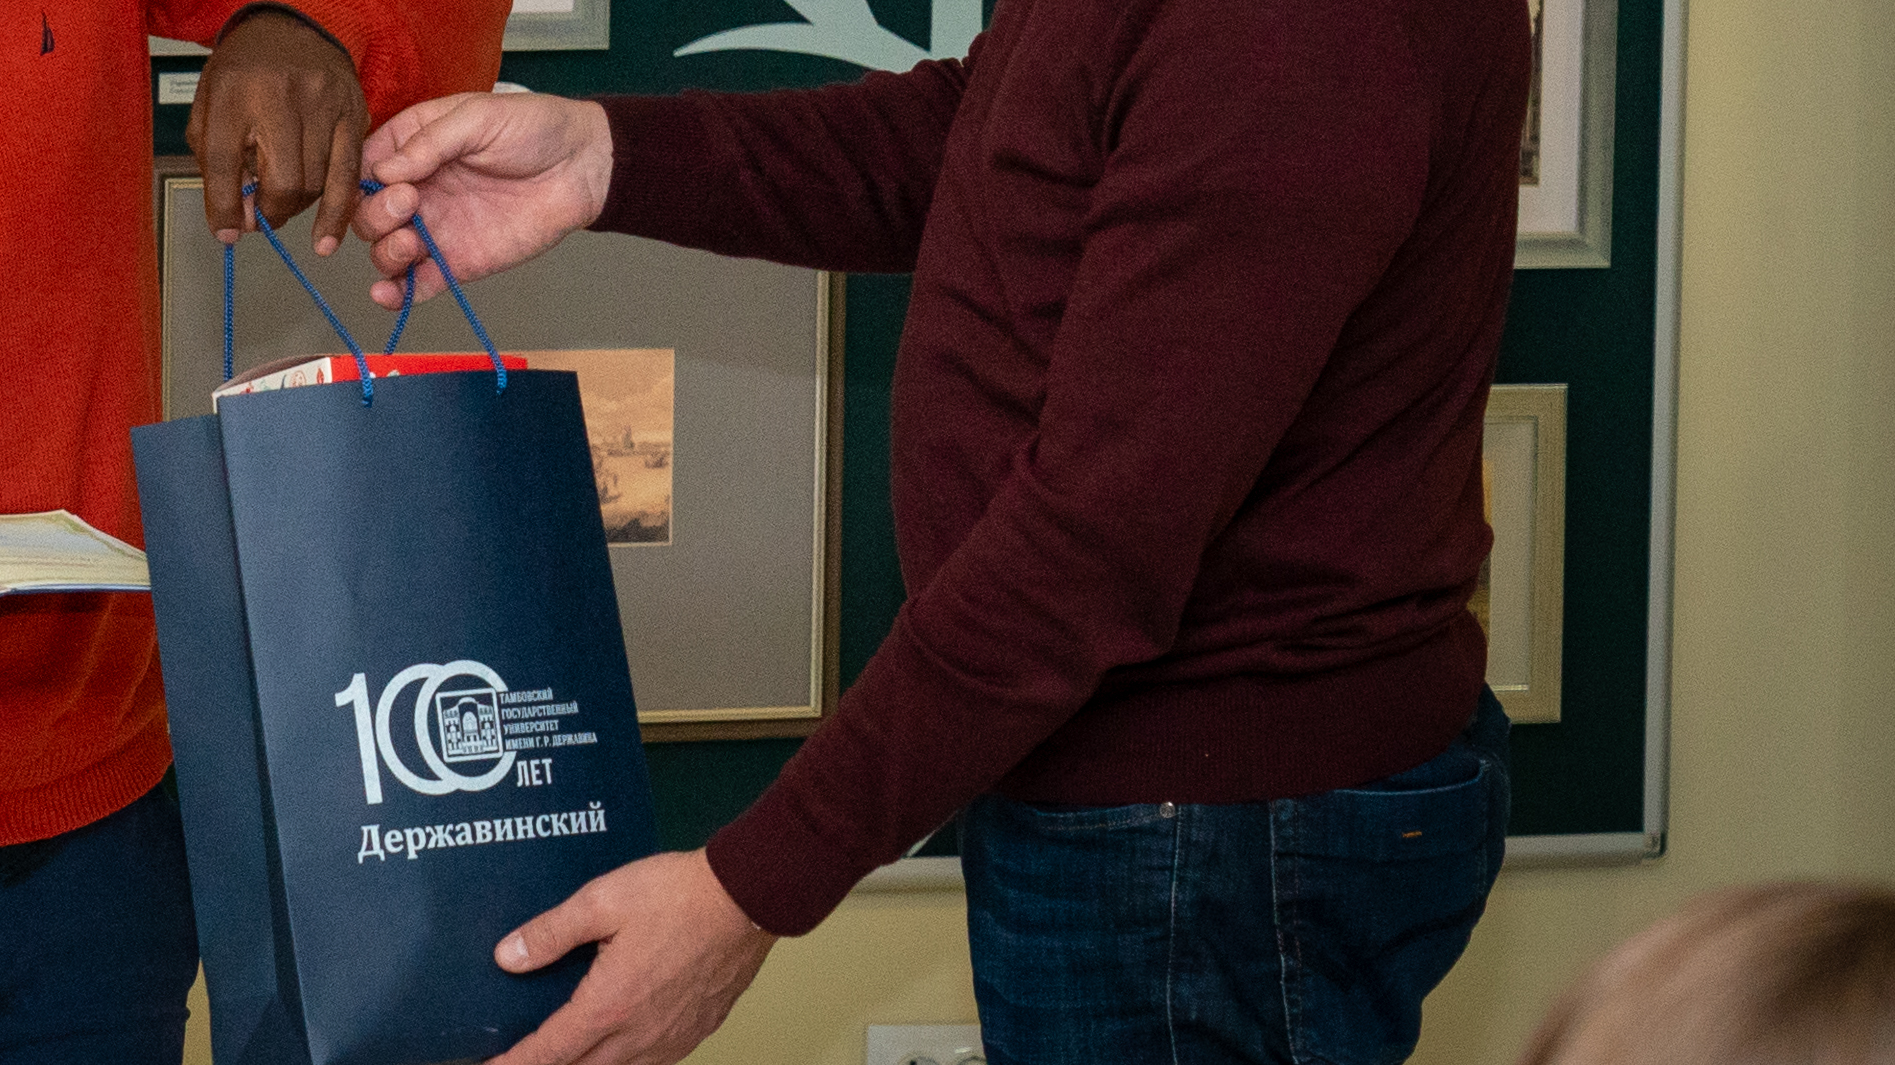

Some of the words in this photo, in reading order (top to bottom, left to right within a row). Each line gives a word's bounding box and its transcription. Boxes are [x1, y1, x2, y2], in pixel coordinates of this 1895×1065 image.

[500, 687, 553, 705] ТАМБОВСКИЙ
[501, 700, 579, 720] ГОСУДАРСТВЕННЫЙ
[334, 659, 518, 805] 100
[503, 719, 559, 735] УНИВЕРСИТЕТ
[506, 737, 535, 750] ИМЕНИ
[552, 732, 598, 748] ДЕРЖАВИНА
[516, 758, 553, 787] ЛЕТ
[357, 800, 607, 864] Державинский
